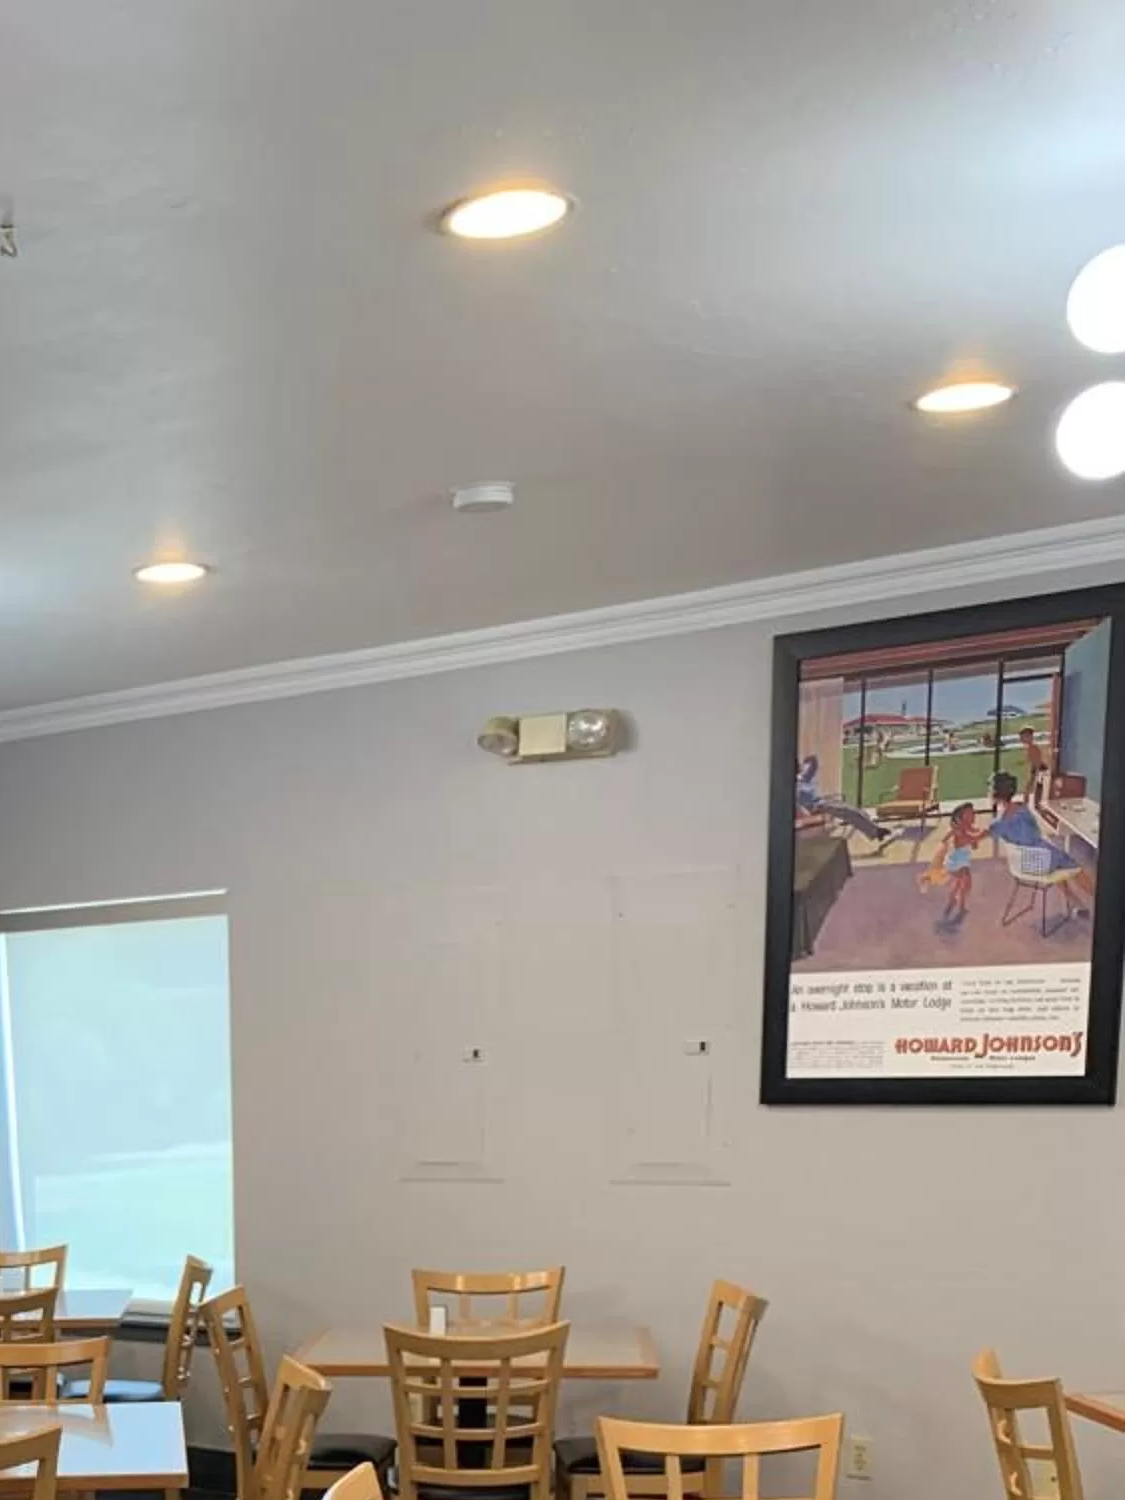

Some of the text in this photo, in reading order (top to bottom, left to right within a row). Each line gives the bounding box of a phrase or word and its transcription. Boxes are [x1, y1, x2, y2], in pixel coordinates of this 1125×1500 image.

[891, 997, 918, 1009] Motor
[923, 996, 953, 1011] Lodge
[895, 1037, 976, 1054] HOWARD
